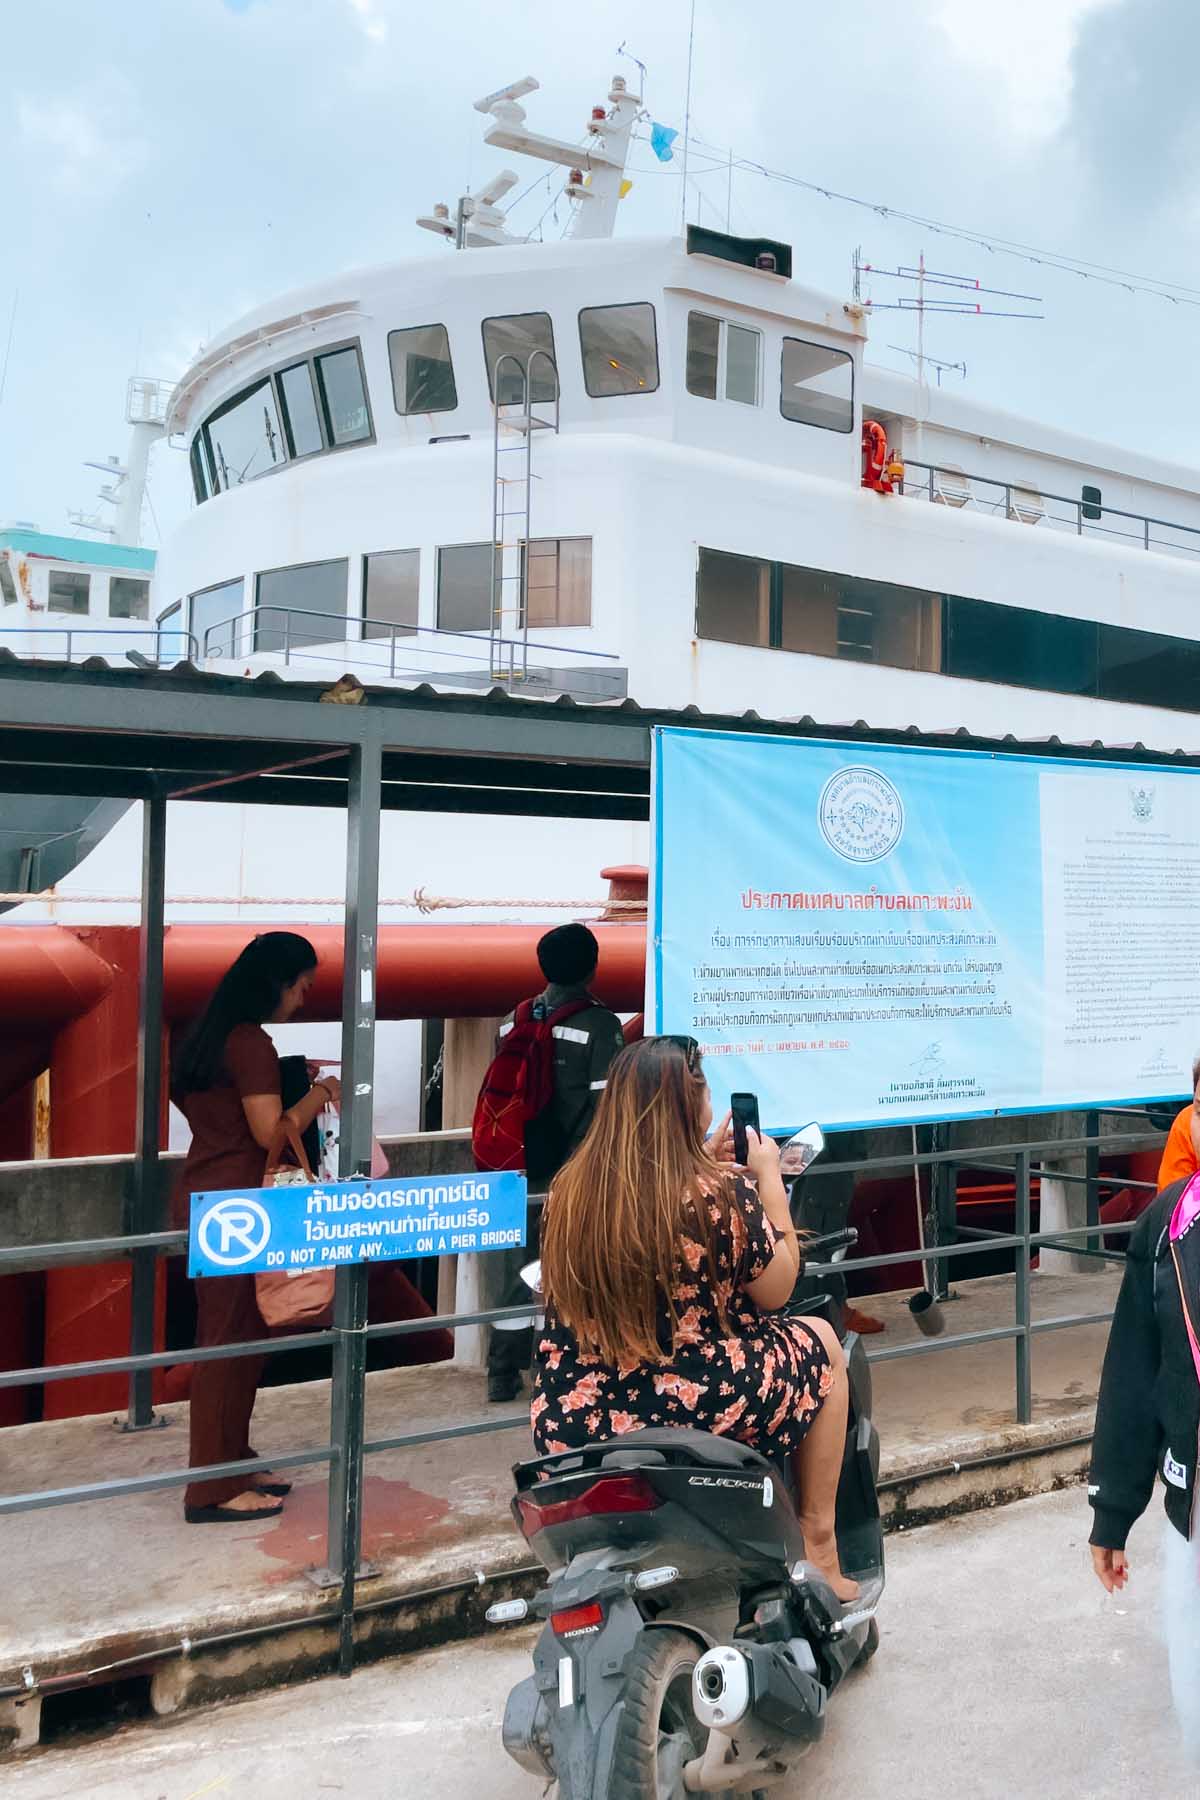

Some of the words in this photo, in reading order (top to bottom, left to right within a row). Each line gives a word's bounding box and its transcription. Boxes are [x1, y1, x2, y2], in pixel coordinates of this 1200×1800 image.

[740, 885, 973, 912] ประกาศเทศบาลตำบลเกาะพะงัน
[711, 925, 731, 948] เรื่อง
[306, 1180, 490, 1214] ห้ามจอดรถทุกชนิด
[304, 1208, 490, 1242] ไว้บนสะพานท่าเทียบเรือ
[266, 1250, 285, 1266] DO
[290, 1247, 316, 1264] NOT
[321, 1245, 353, 1262] PARK
[416, 1238, 433, 1253] ON
[437, 1237, 447, 1250] A
[451, 1233, 477, 1249] PIER
[481, 1229, 522, 1247] BRIDGE
[564, 1625, 600, 1639] HONDA
